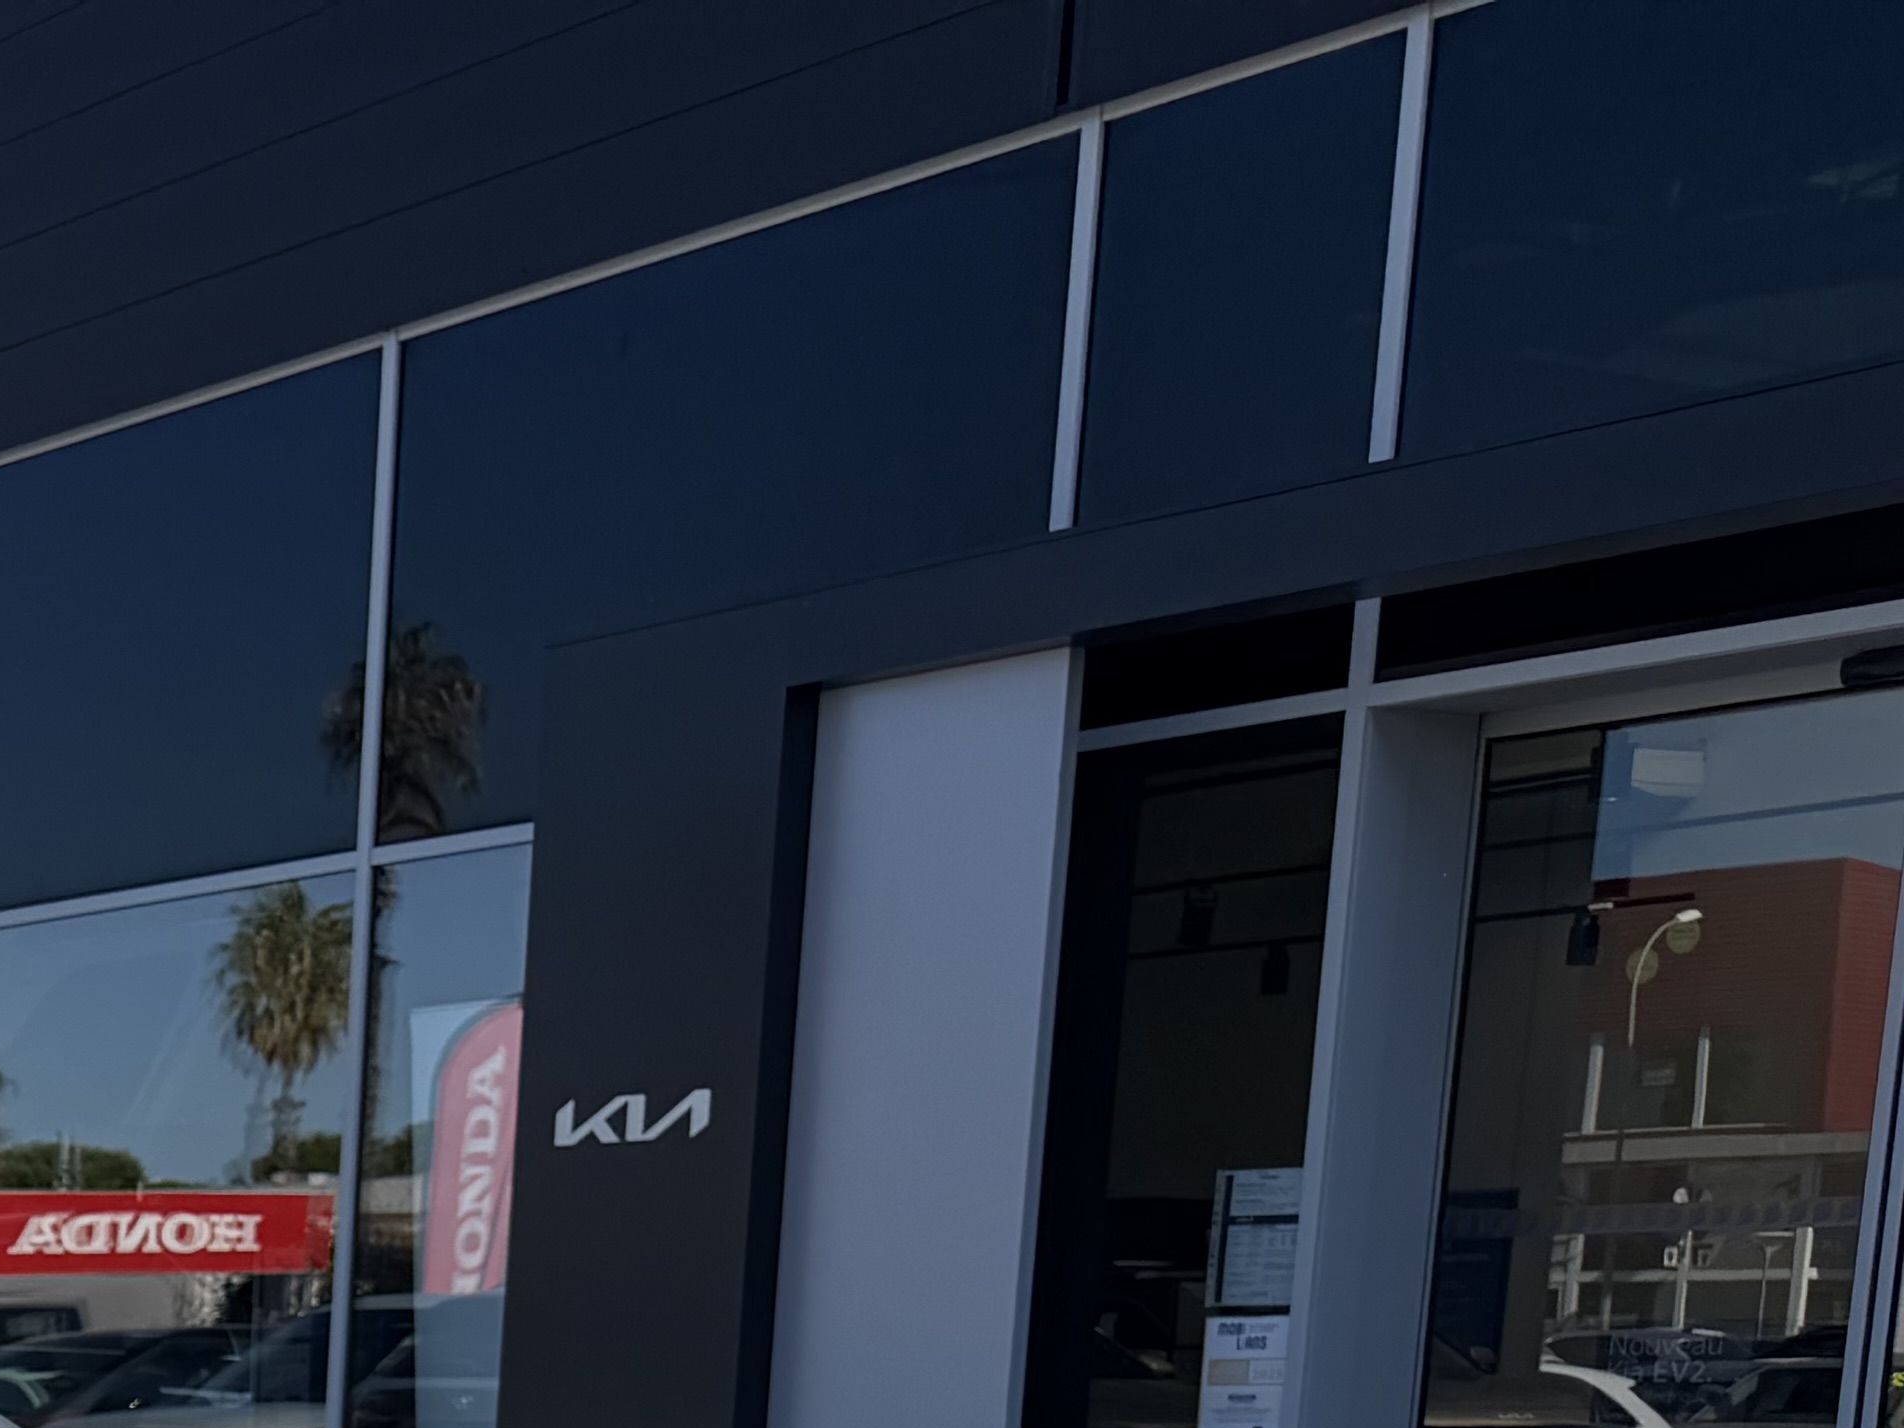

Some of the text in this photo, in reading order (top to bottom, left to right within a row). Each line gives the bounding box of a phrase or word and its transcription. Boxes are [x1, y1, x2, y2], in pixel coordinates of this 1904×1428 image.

[553, 1088, 712, 1147] KIA
[1608, 1334, 1723, 1357] Nouveau
[1653, 1360, 1712, 1384] EV2.
